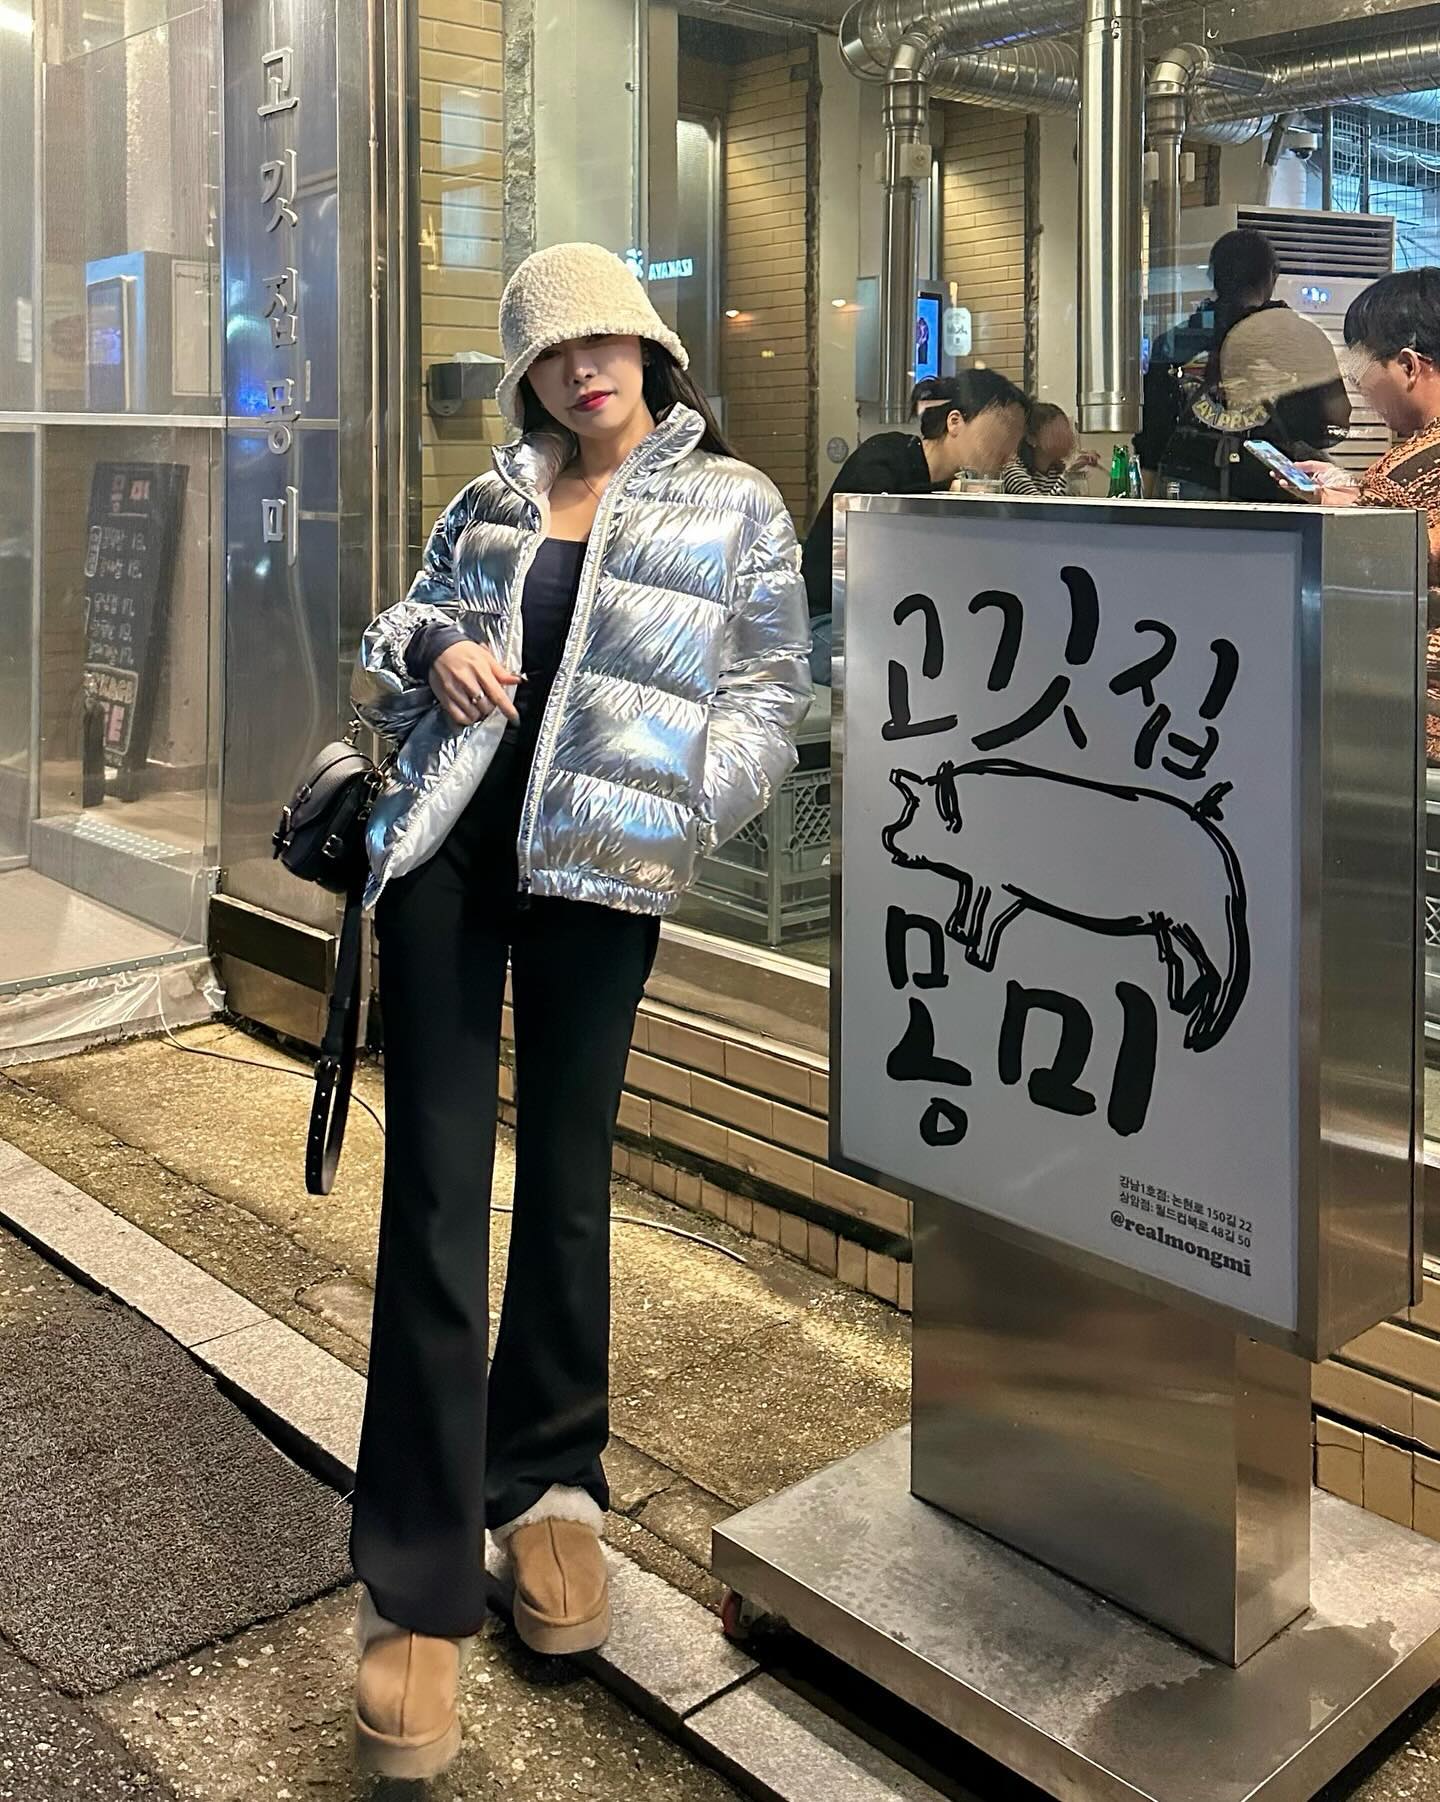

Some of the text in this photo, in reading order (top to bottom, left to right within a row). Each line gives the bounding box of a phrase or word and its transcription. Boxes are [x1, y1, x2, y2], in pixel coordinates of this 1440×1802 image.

[1207, 1207, 1236, 1228] 150길
[1239, 1218, 1252, 1233] 22
[1110, 1210, 1252, 1277] @realmongmi
[1211, 1225, 1235, 1243] 48길
[1237, 1234, 1251, 1248] 50
